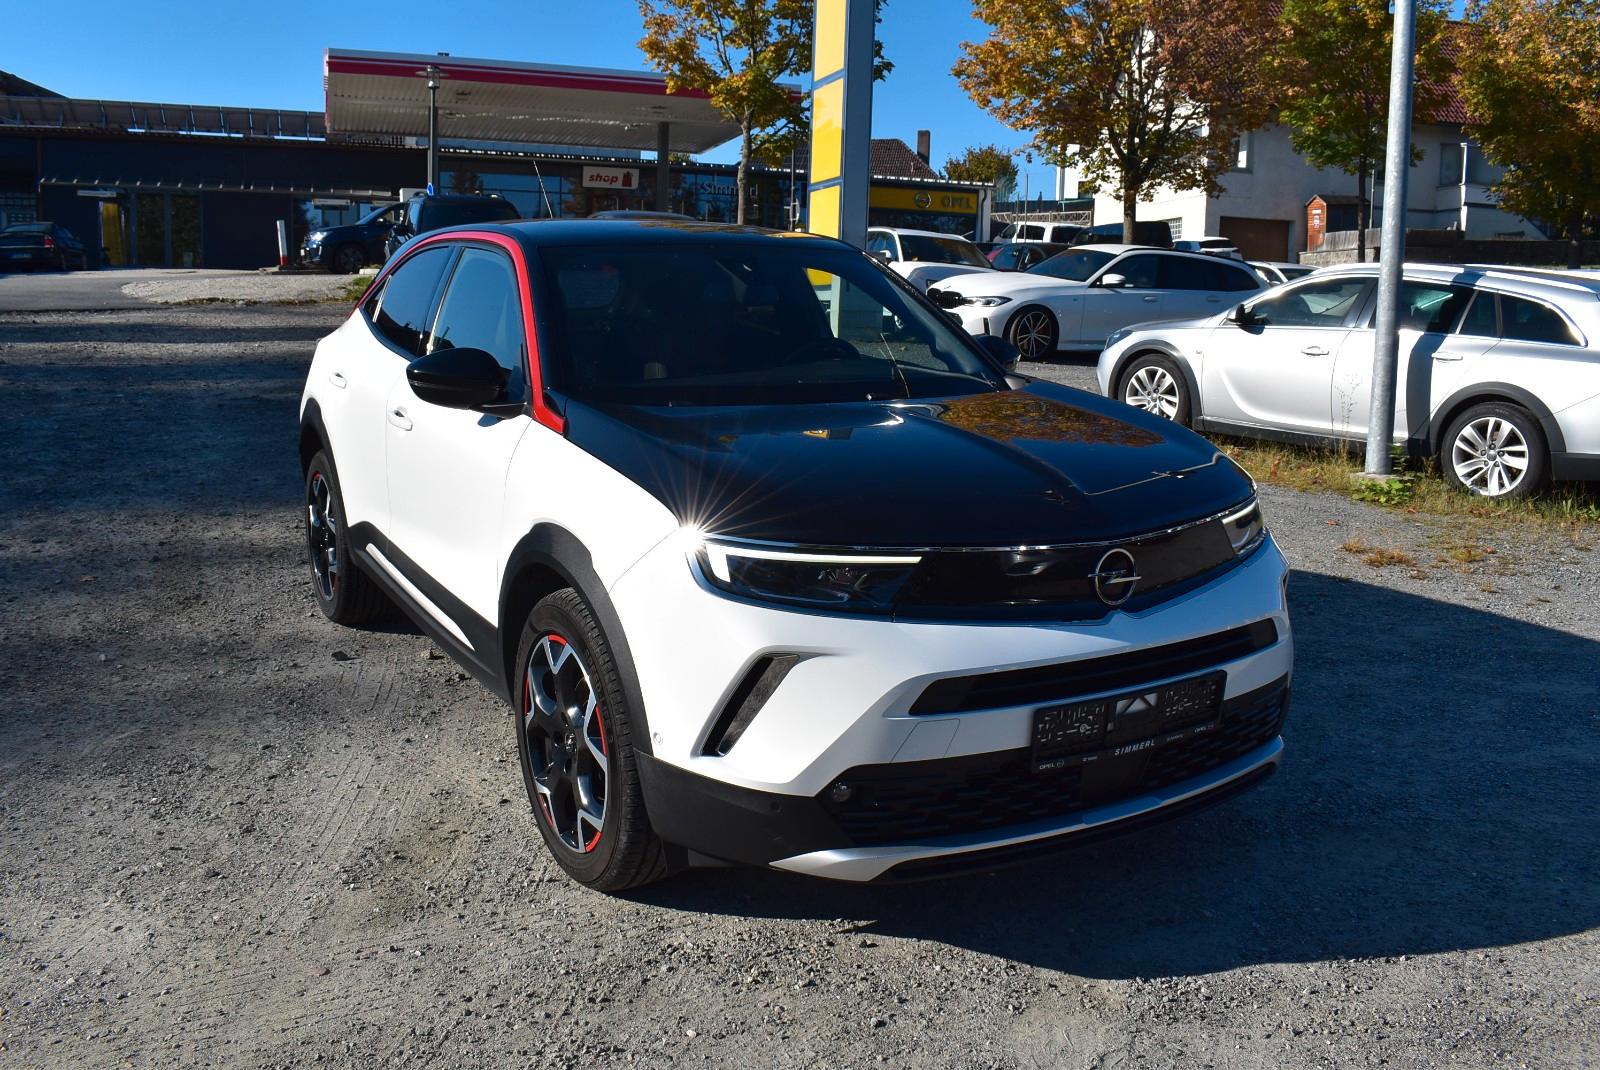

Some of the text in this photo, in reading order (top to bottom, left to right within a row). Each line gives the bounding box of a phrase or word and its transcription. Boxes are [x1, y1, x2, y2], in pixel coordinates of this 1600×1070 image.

[588, 172, 619, 185] shop
[703, 182, 758, 196] Simmrl
[941, 195, 972, 209] OPEL
[1114, 739, 1156, 756] SIMMERL
